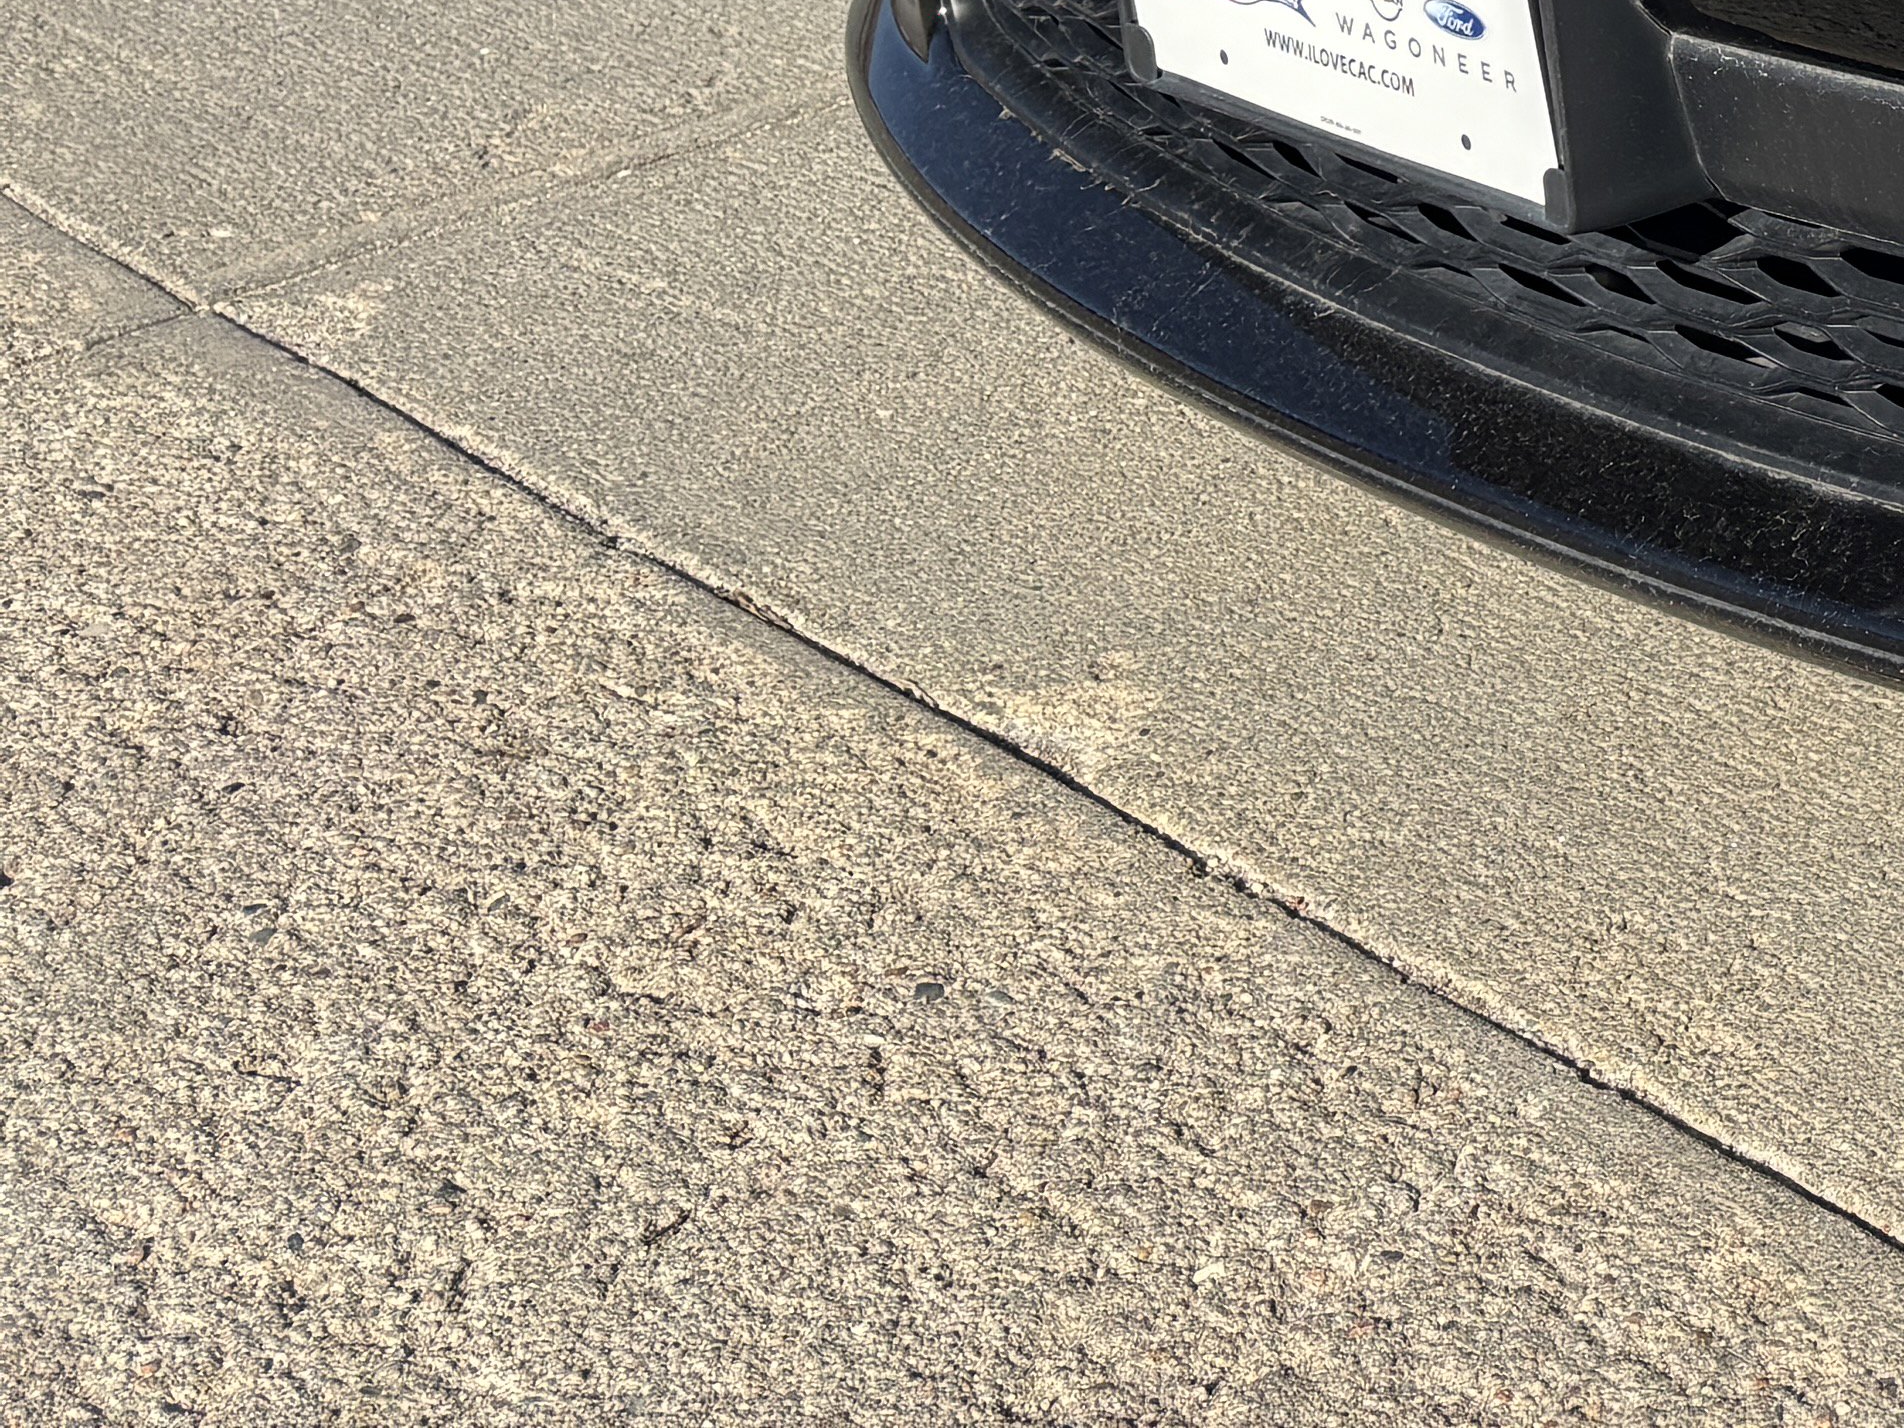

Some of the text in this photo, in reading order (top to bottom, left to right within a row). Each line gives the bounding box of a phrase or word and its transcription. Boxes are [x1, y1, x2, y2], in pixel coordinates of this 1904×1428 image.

[1336, 12, 1518, 93] WAGONEER
[1436, 5, 1475, 36] Ford
[1264, 28, 1415, 97] WWW.ILOVECAC.COM
